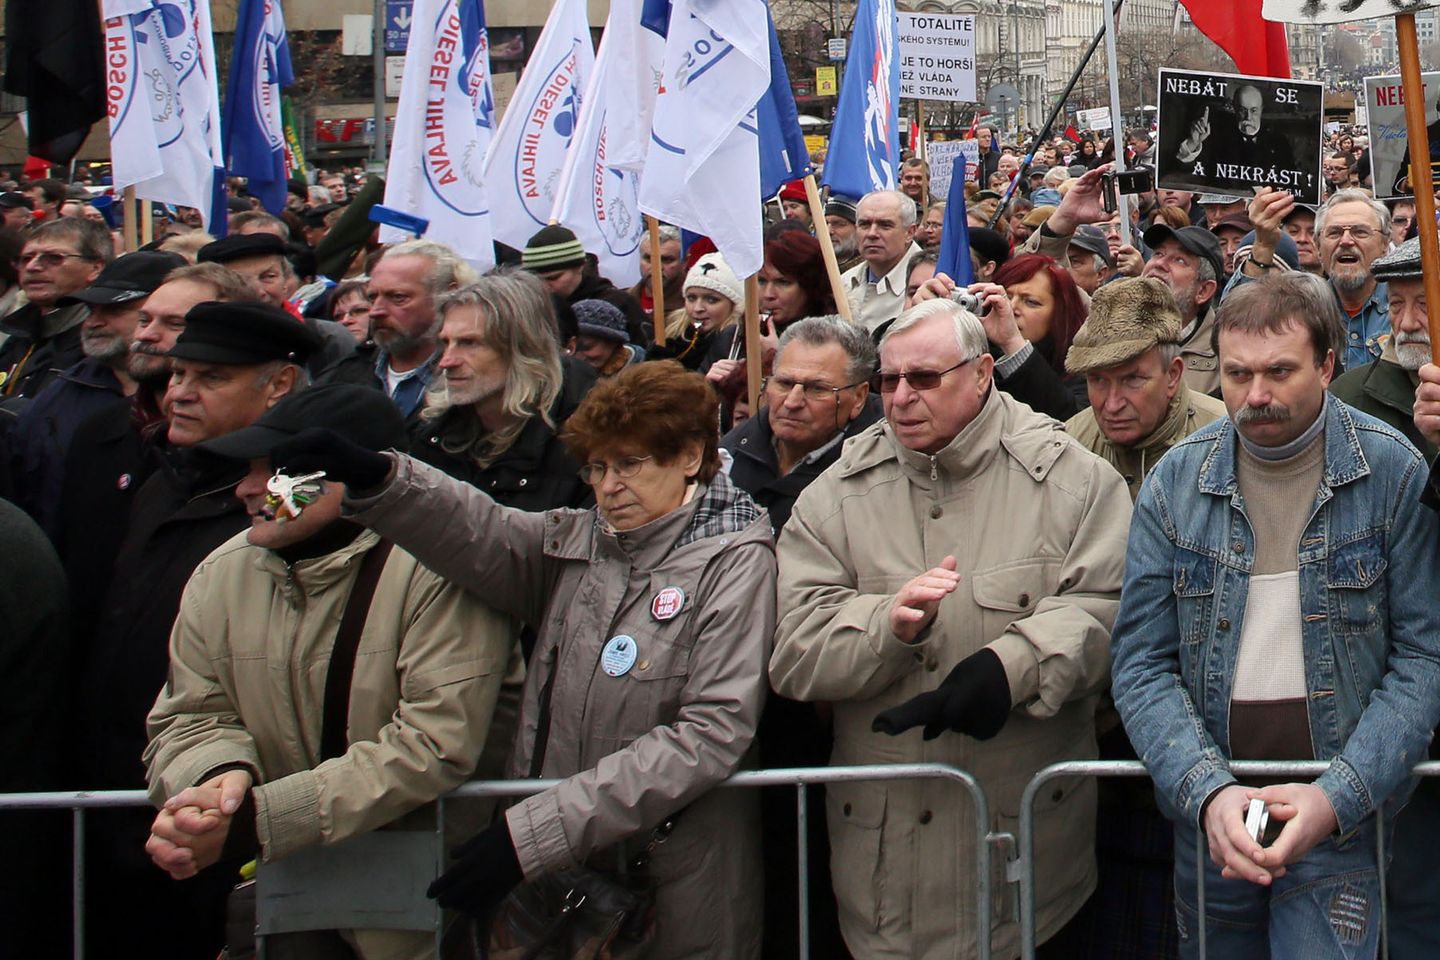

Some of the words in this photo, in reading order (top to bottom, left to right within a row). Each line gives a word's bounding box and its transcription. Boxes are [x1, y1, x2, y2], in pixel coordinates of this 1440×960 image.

[910, 17, 972, 31] TOTALITĚ
[901, 56, 915, 67] JE
[918, 57, 934, 68] TO
[937, 57, 974, 71] HORŠÍ
[918, 70, 953, 83] VLÁDA
[919, 85, 960, 97] STRANY
[1166, 77, 1228, 98] NEBÁT
[1275, 88, 1300, 104] SE
[1192, 161, 1207, 177] A
[1216, 163, 1303, 186] NEKRÁST
[594, 166, 606, 221] BOSCH
